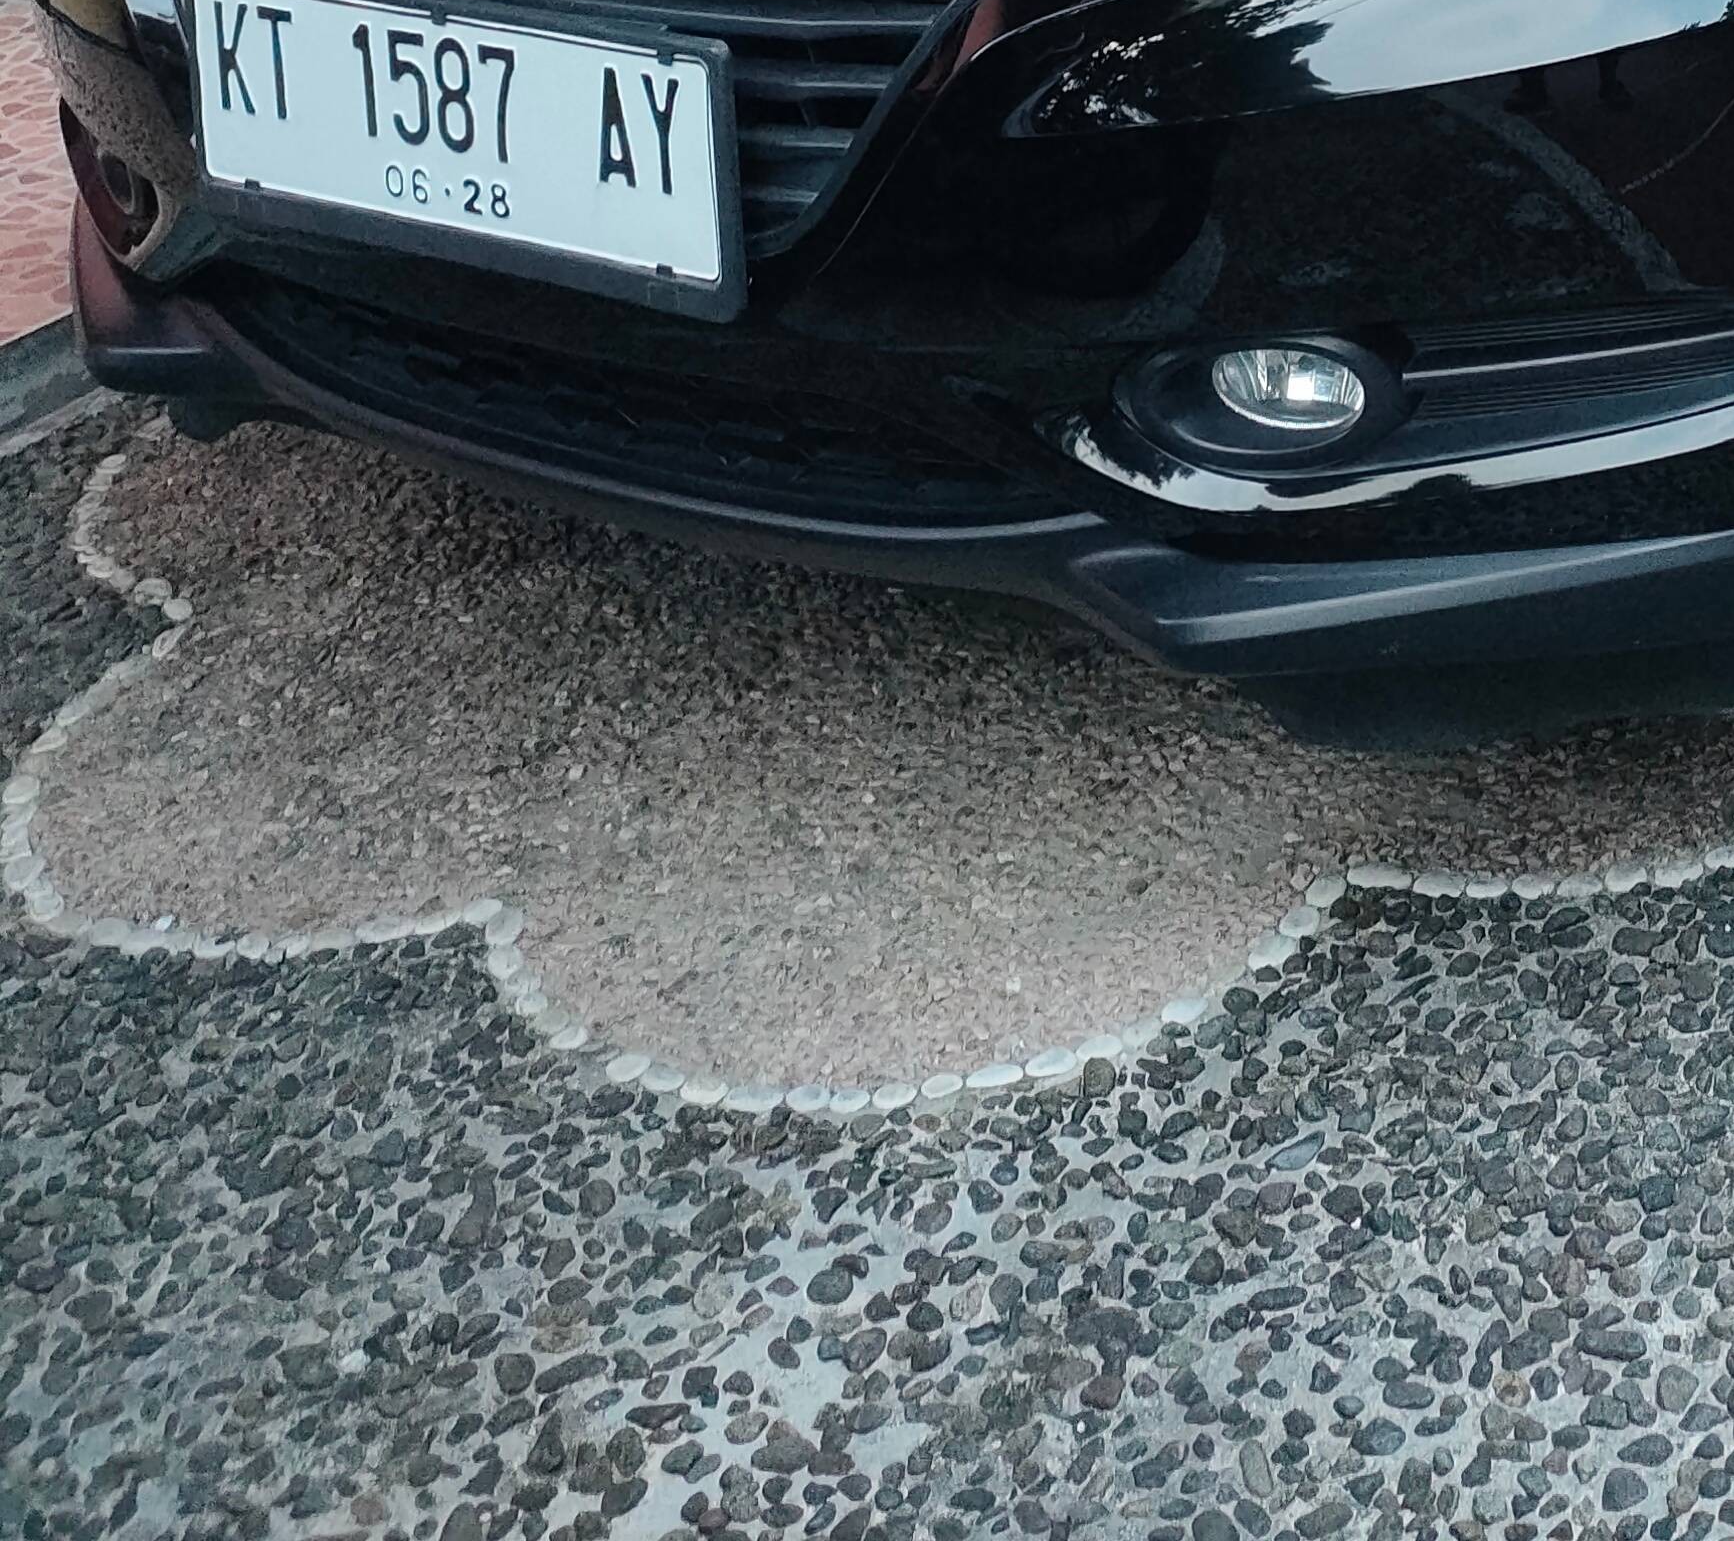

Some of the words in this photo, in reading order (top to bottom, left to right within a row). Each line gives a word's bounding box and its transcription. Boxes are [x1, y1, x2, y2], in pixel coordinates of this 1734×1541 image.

[213, 1, 291, 119] KT
[352, 22, 516, 164] 1587
[600, 66, 681, 195] AY
